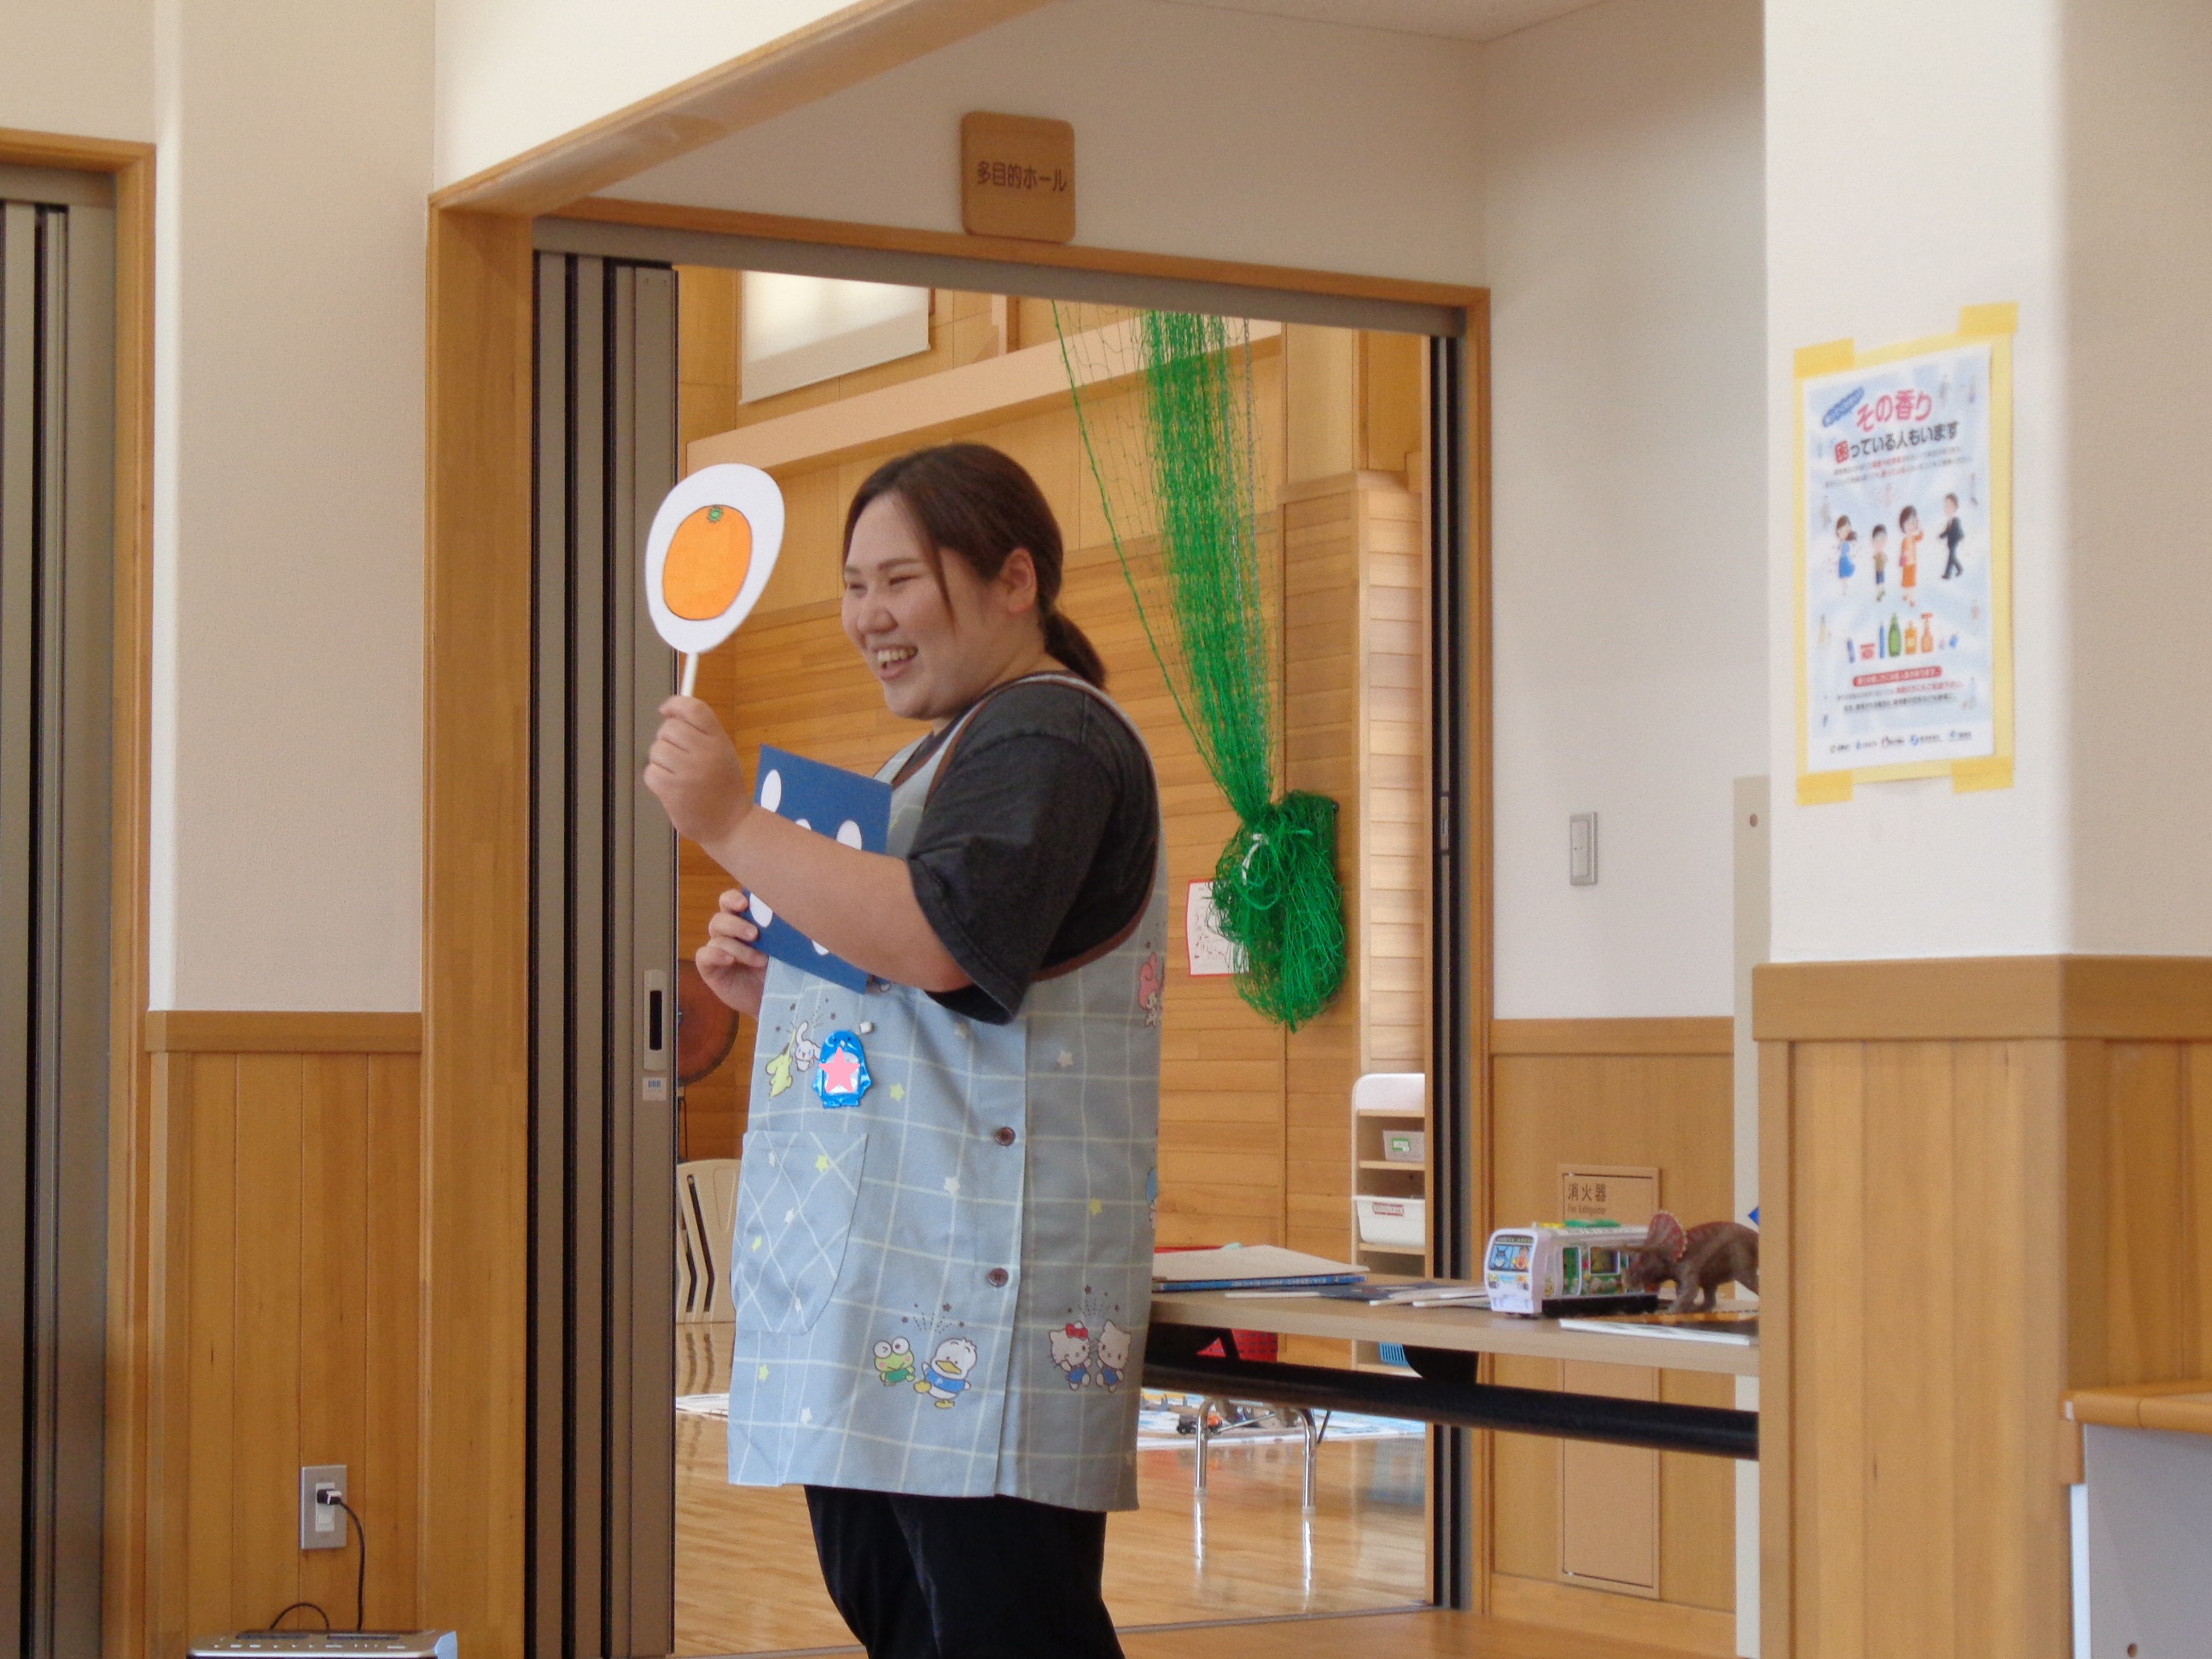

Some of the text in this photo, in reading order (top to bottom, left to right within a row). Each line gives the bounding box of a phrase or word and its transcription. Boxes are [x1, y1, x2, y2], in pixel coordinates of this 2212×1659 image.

[977, 160, 1068, 192] 多目的ホール
[1857, 389, 1932, 432] その香り
[1835, 422, 1958, 463] 困っている人もいます
[1568, 1183, 1607, 1202] 消火器
